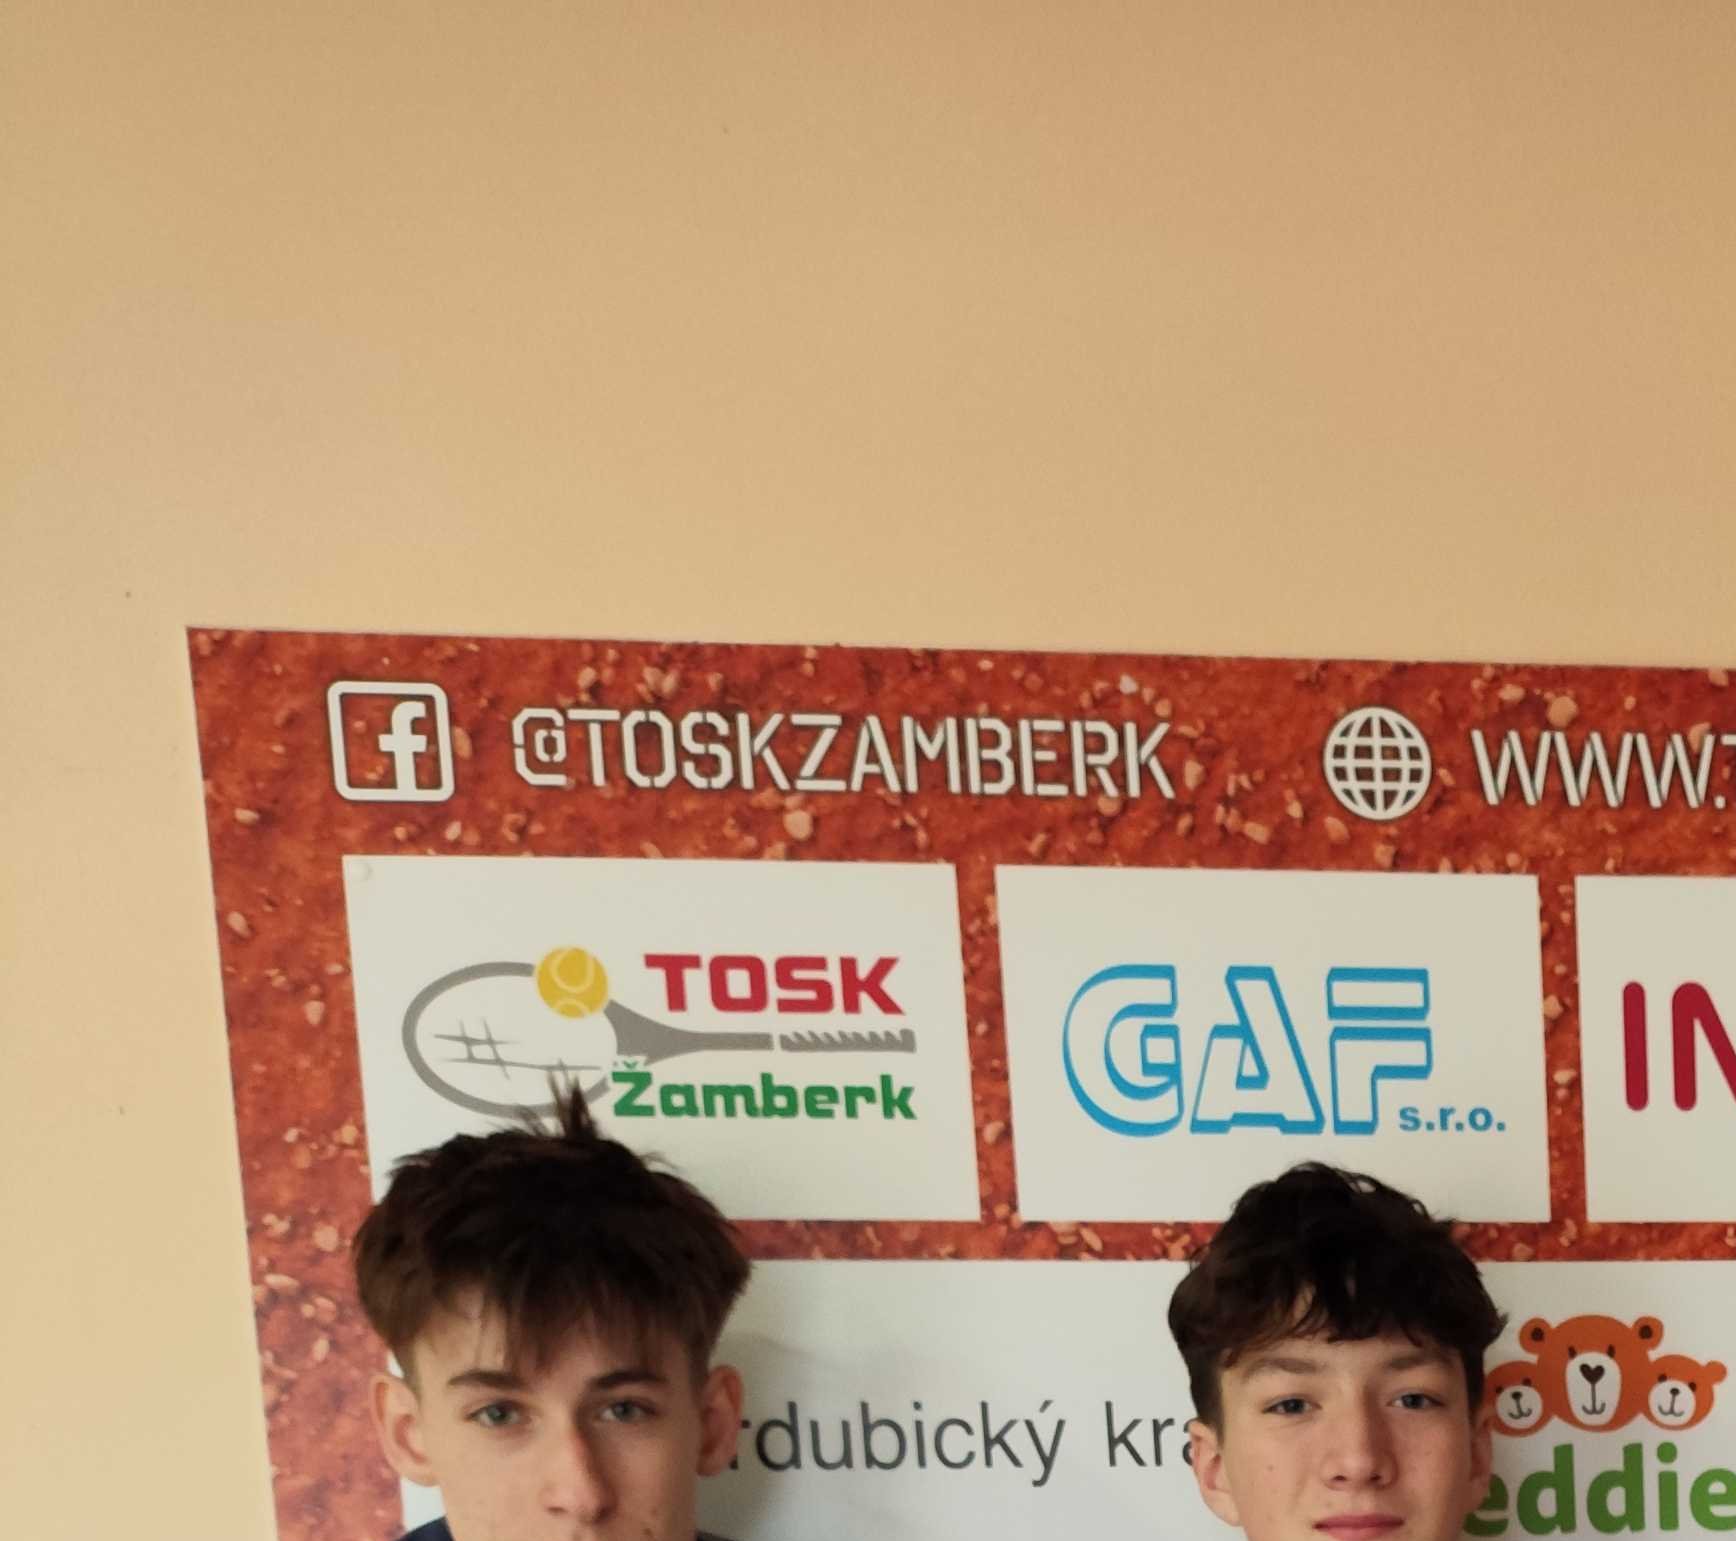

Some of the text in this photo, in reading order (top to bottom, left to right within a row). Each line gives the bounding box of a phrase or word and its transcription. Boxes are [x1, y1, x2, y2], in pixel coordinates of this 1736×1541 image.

[512, 706, 1175, 799] @TOSKZAMBERK
[645, 953, 905, 1016] TOSK
[1062, 963, 1507, 1137] GAF s.r.o.
[611, 1060, 917, 1121] Žamberk
